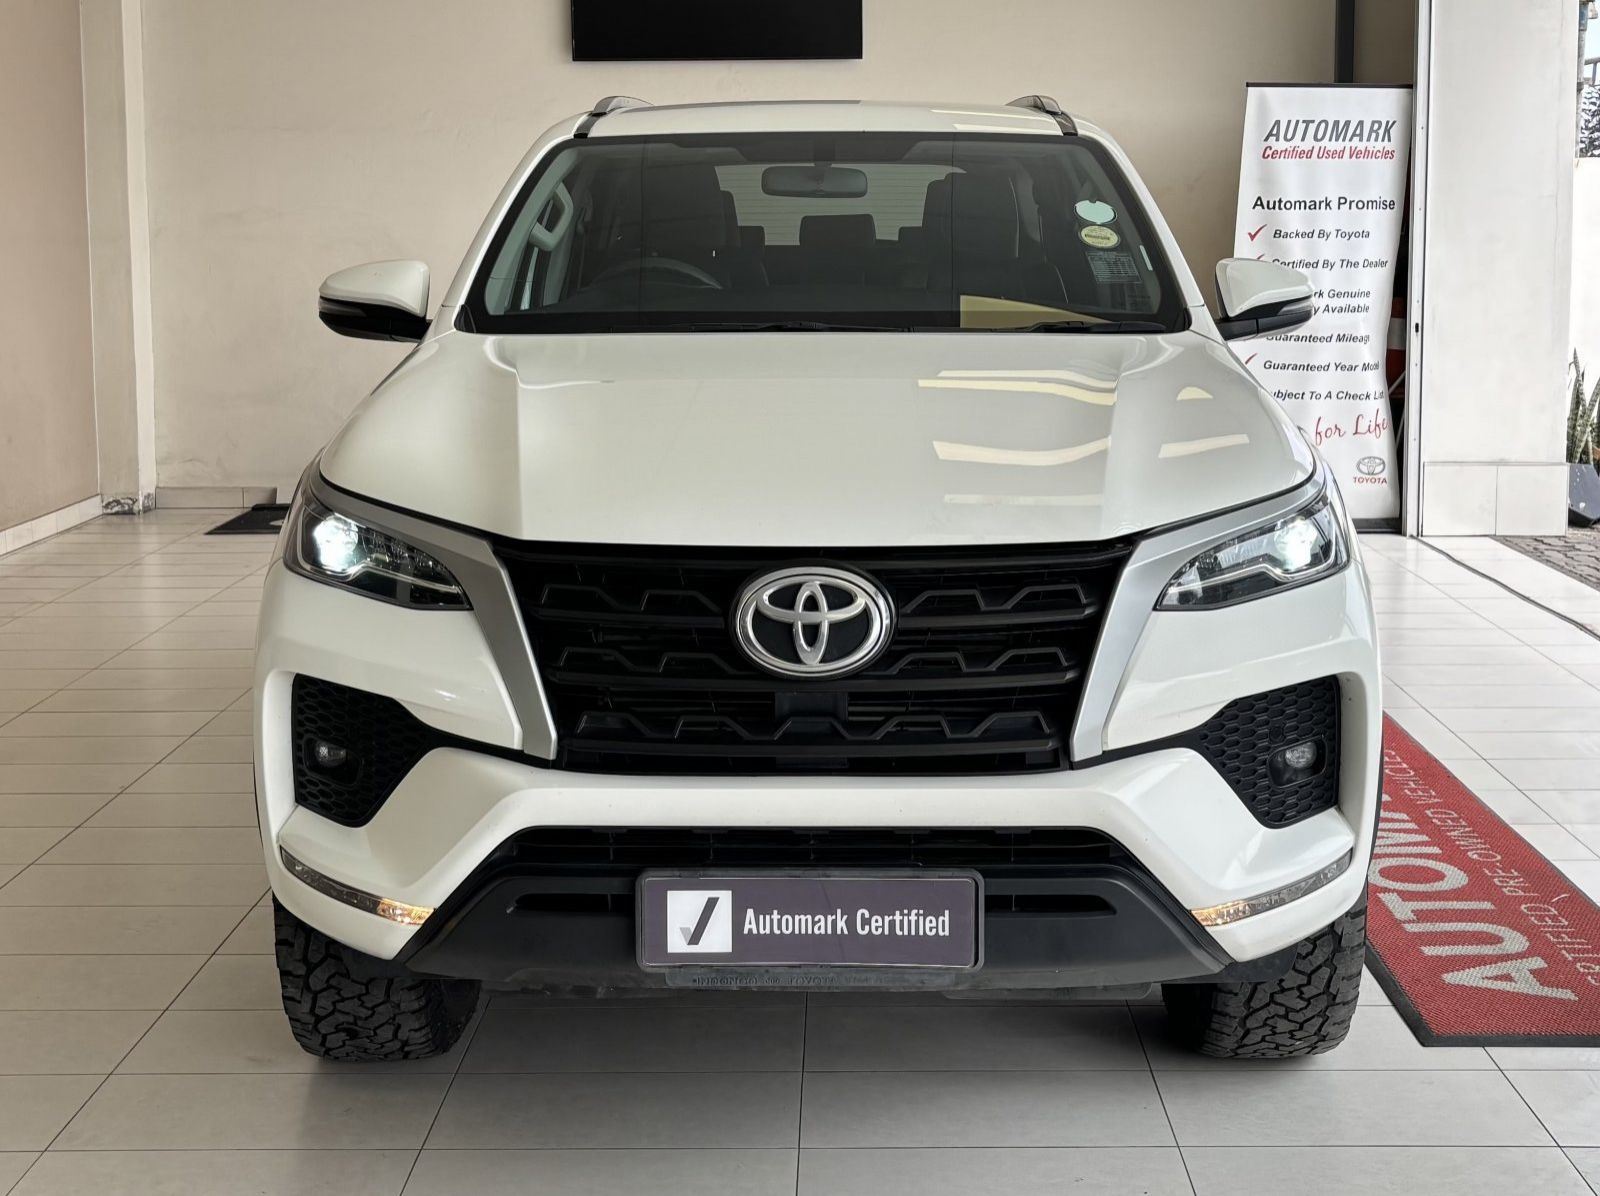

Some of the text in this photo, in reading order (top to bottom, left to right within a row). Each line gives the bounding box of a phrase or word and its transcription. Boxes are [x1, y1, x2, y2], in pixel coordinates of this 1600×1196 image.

[1263, 119, 1397, 143] AUTOMARK
[1262, 145, 1396, 160] Certified Used Vehicles
[1252, 195, 1396, 211] Automark Promise
[1273, 229, 1370, 241] Backed By Toyota
[1322, 259, 1336, 271] By
[1339, 258, 1360, 269] The
[1362, 258, 1388, 269] Dealer
[1327, 288, 1371, 299] Genuine
[1322, 304, 1370, 314] Available
[1263, 359, 1330, 372] Guaranteed
[1334, 361, 1359, 372] Year
[1273, 389, 1306, 402] bject
[1309, 390, 1322, 400] To
[1324, 390, 1332, 400] A
[1336, 390, 1371, 401] Check
[1314, 415, 1346, 446] for
[1353, 475, 1388, 485] TOYOTA
[743, 908, 950, 937] Automark Certified
[1520, 902, 1600, 987] RTIFIED
